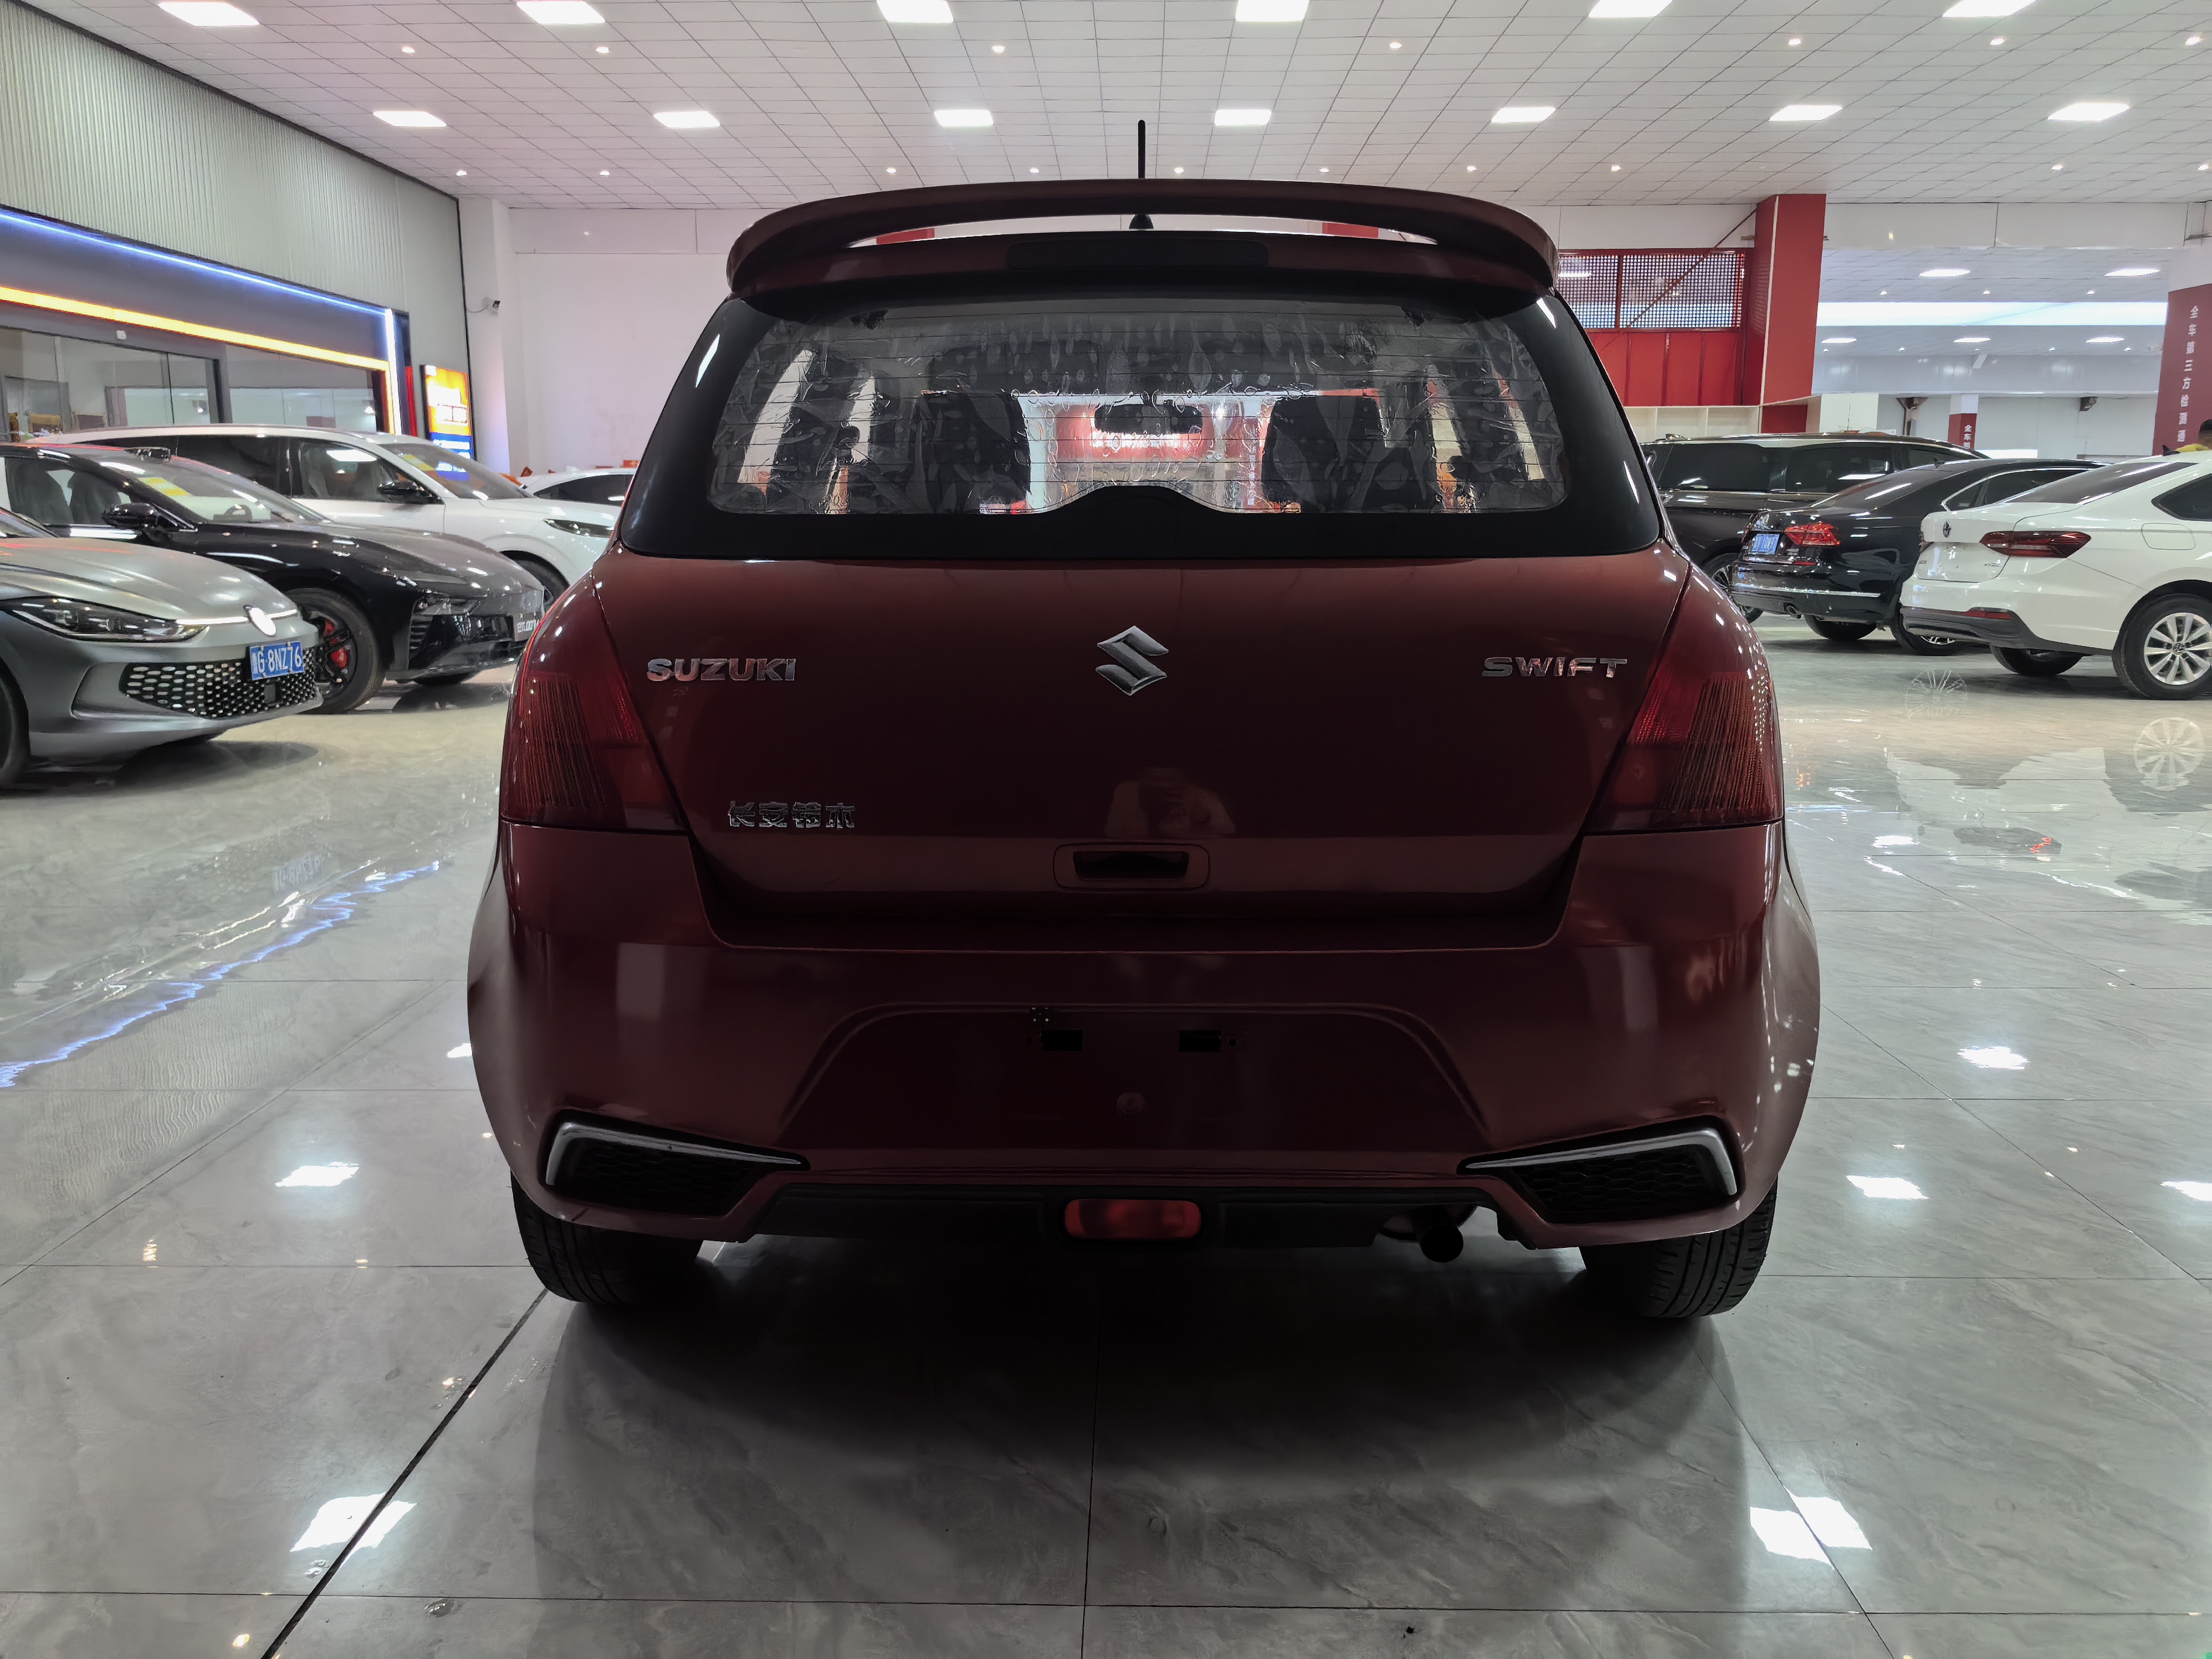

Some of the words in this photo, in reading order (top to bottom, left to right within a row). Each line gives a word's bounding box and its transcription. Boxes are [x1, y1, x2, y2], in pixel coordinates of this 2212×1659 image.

[647, 658, 796, 682] SUZUKI
[1482, 657, 1627, 678] SWIFT
[728, 800, 855, 829] 长安铃木
